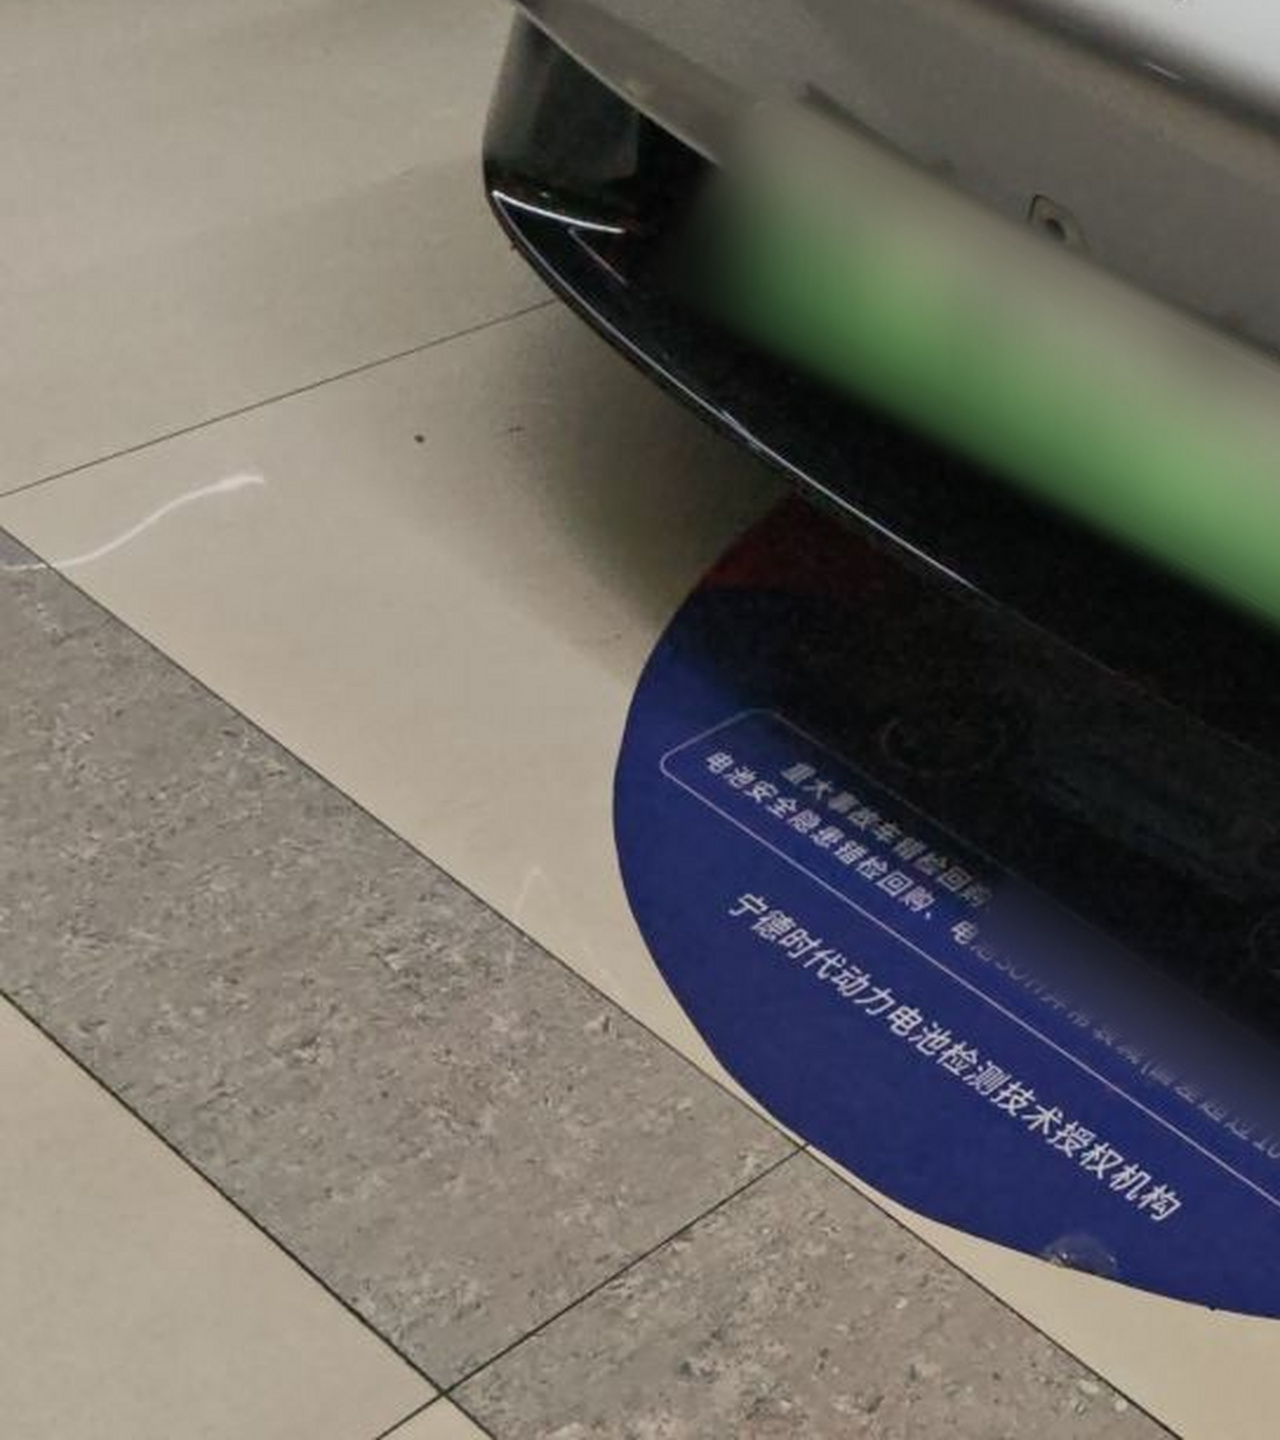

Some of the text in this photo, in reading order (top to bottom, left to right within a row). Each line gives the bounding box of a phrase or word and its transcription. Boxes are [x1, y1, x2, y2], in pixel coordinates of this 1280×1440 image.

[726, 891, 1183, 1222] 宁德时代动力电池检测技术授权机构
